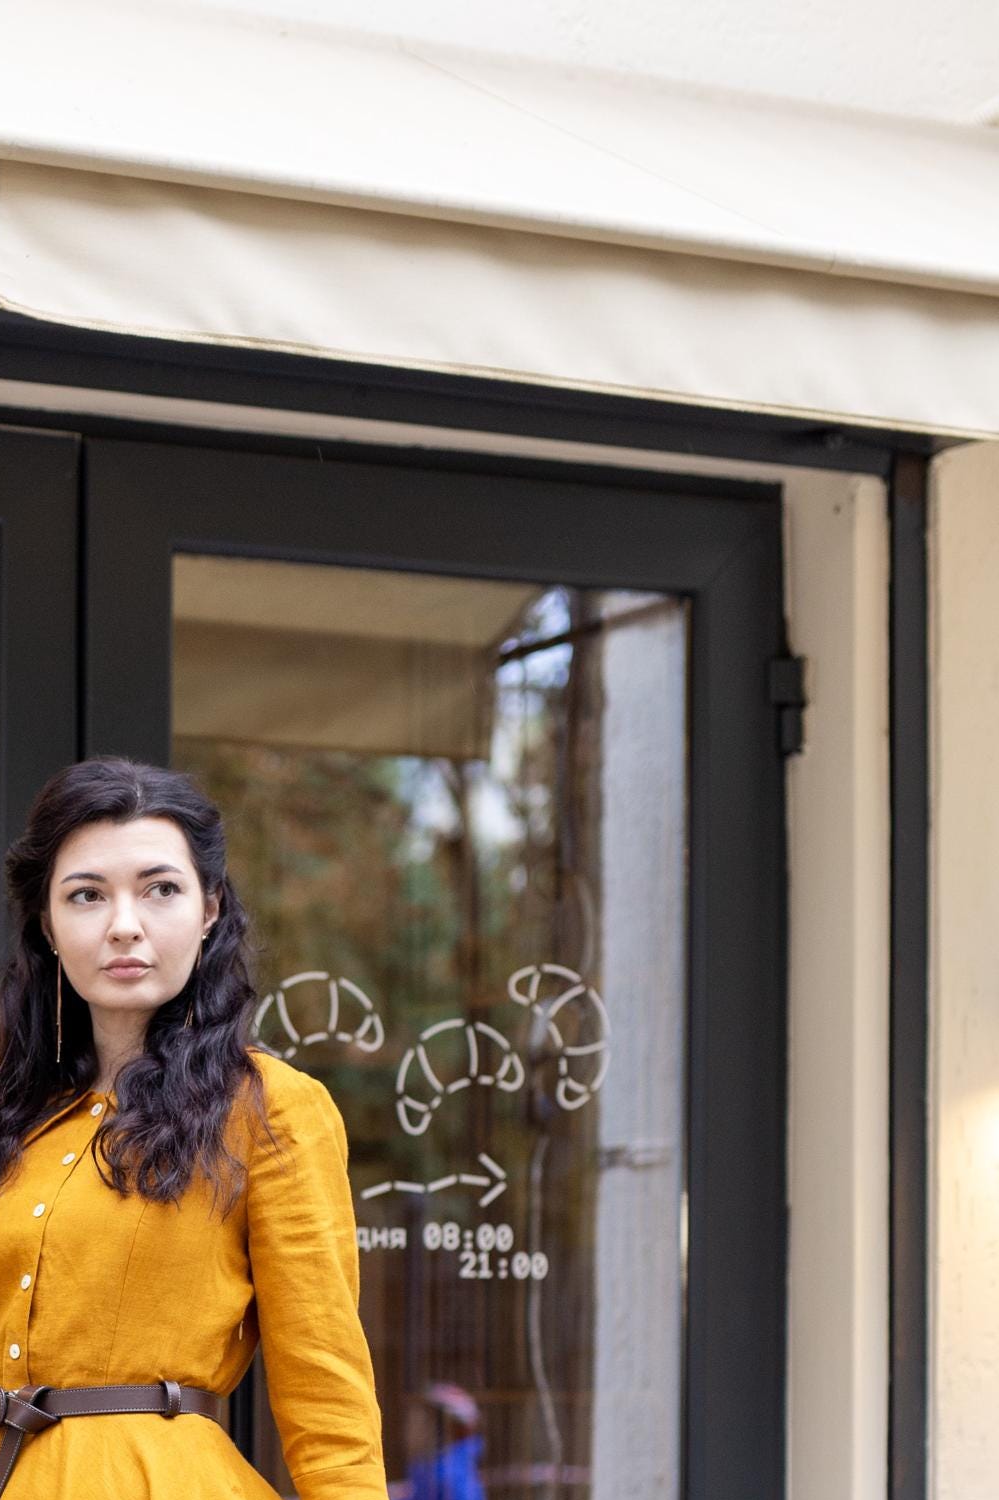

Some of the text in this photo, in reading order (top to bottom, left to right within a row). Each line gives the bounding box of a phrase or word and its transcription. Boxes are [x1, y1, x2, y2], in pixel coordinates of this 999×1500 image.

[356, 1222, 514, 1252] дня 08:00
[459, 1251, 549, 1279] 21:00
